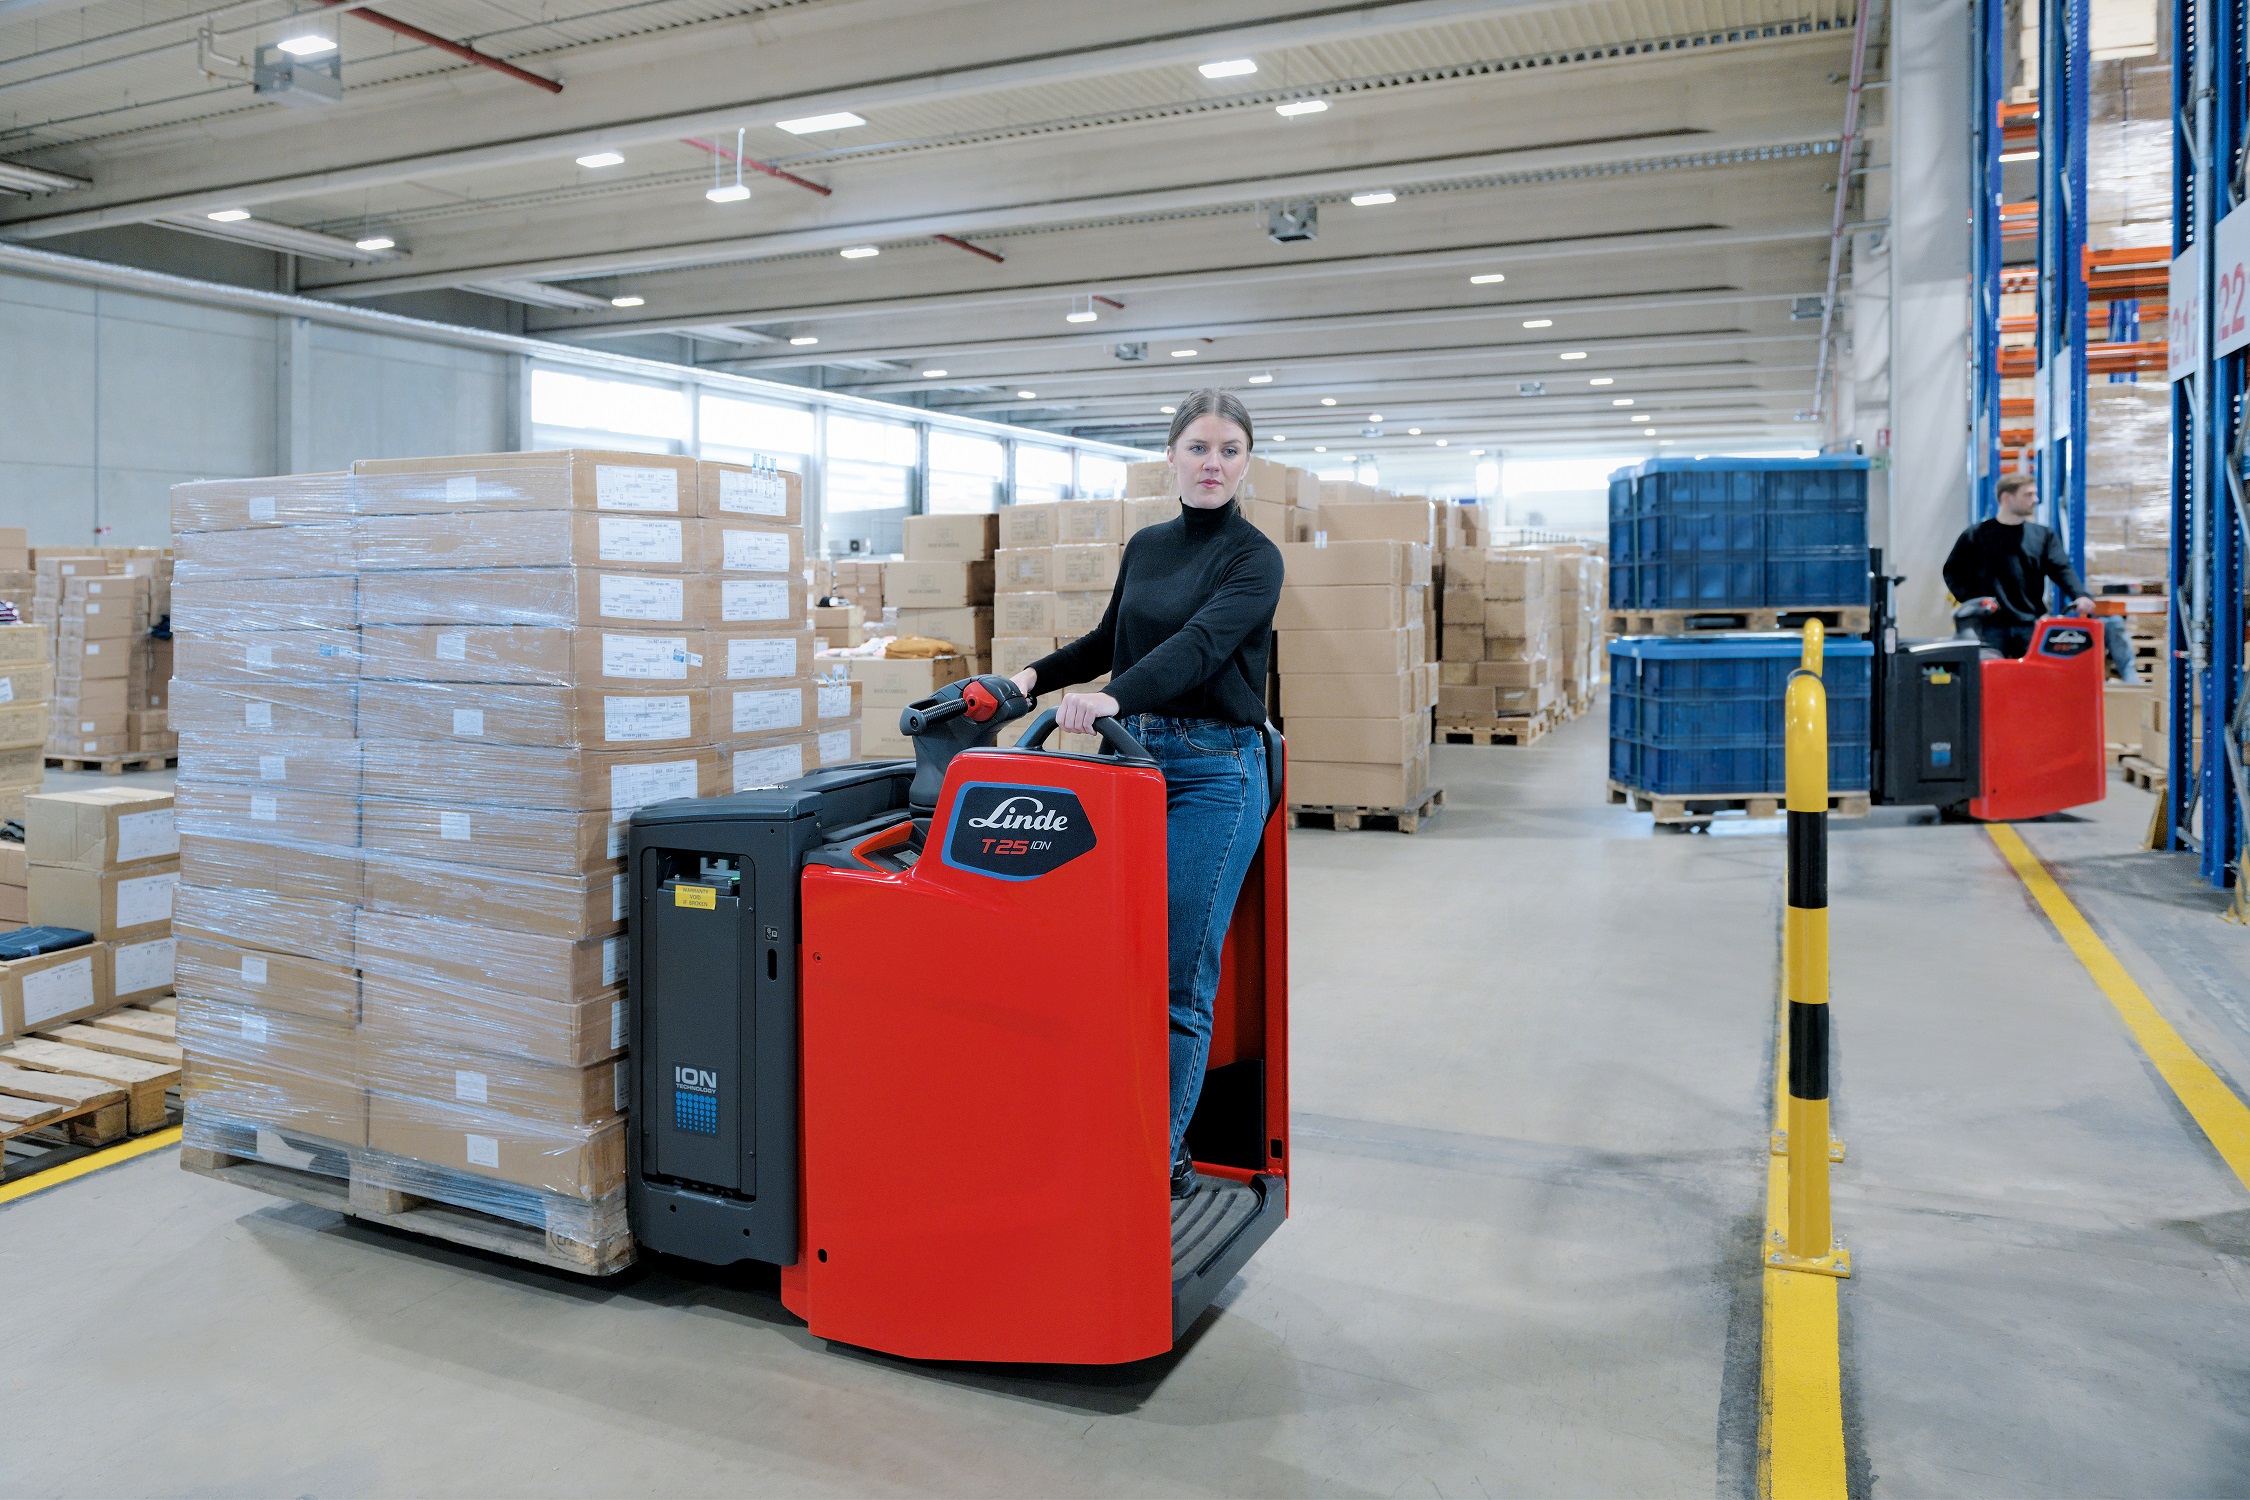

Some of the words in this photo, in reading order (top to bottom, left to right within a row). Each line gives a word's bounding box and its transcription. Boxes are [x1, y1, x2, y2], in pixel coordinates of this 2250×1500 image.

[2217, 262, 2250, 342] 22
[968, 796, 1068, 831] Linde
[1030, 840, 1052, 850] ION
[675, 1066, 717, 1088] ION
[676, 1083, 716, 1094] TECHNOLOGY
